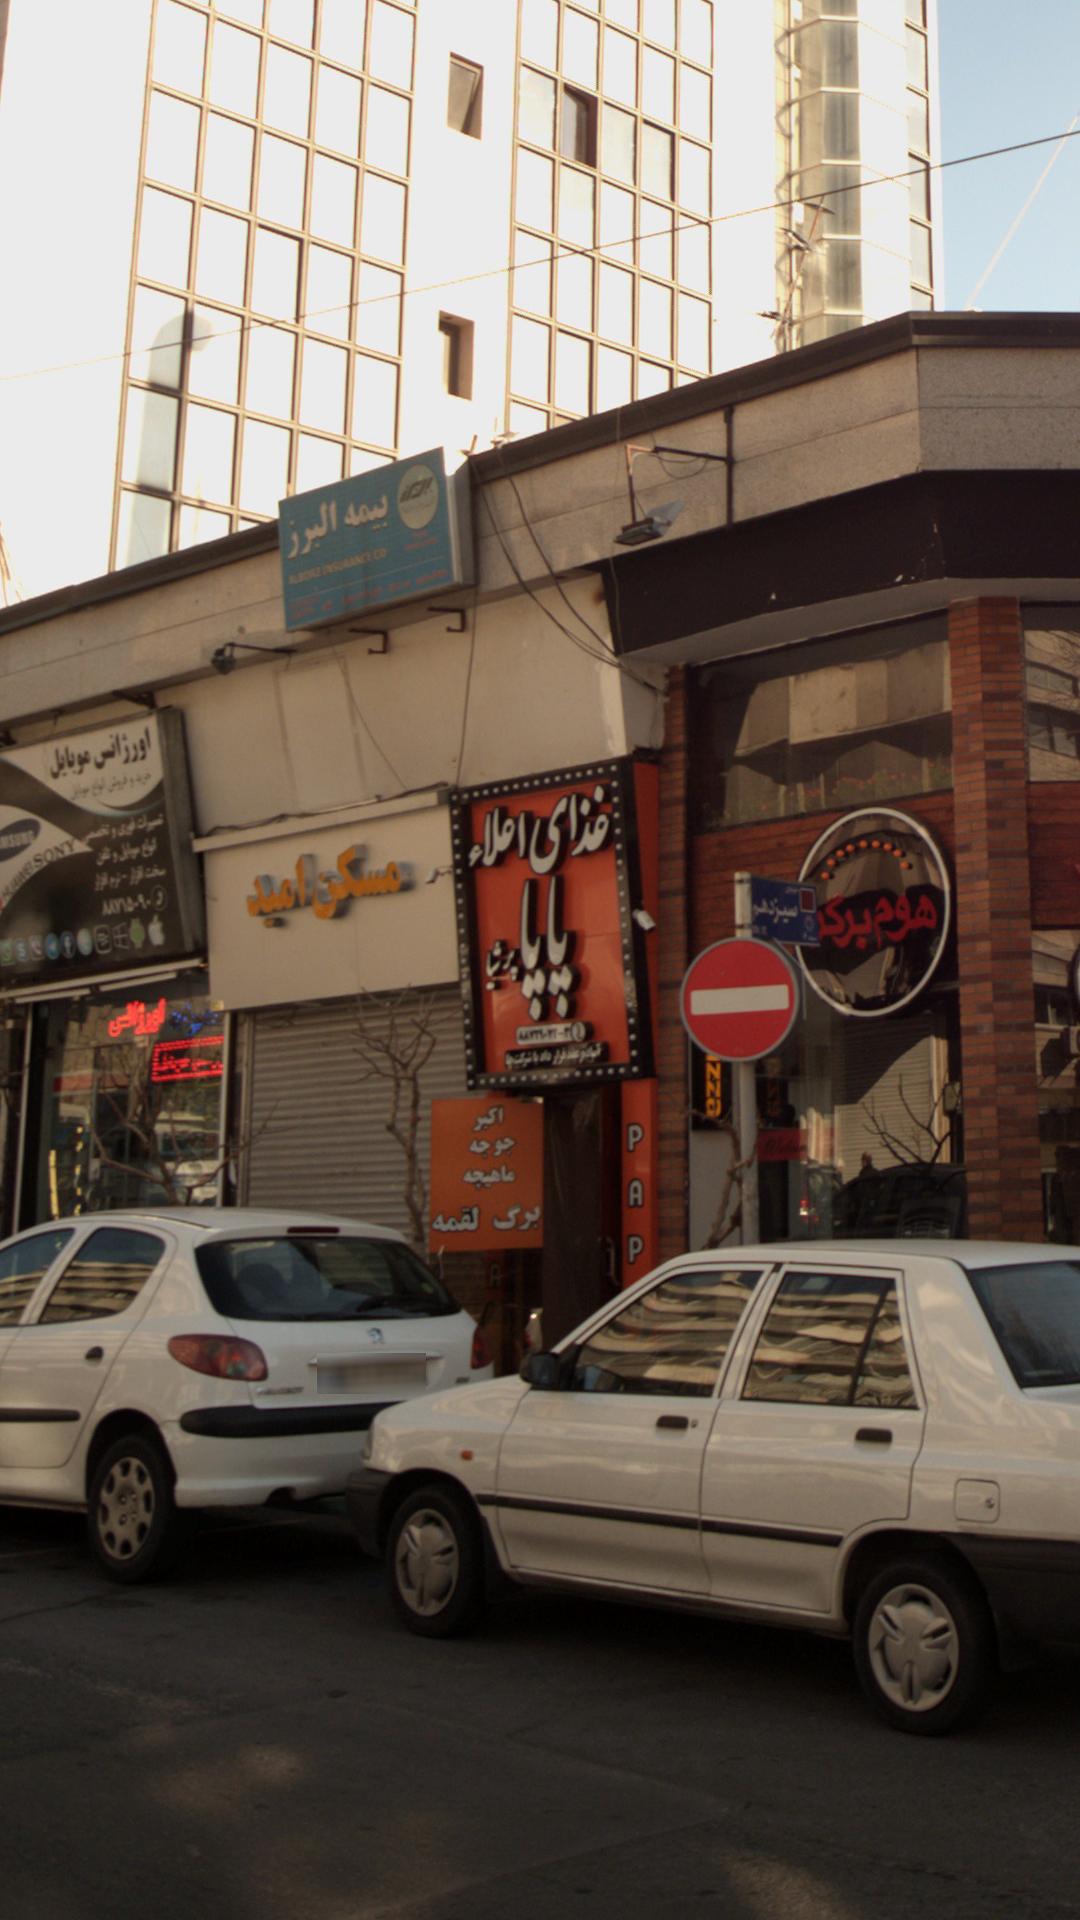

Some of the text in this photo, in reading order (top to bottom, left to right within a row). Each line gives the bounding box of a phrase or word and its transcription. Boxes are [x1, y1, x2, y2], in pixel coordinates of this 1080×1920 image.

[287, 495, 389, 560] بیمه البرز
[50, 727, 151, 779] اورژانس موبایل
[530, 785, 610, 874] غذای
[32, 837, 76, 868] SONY
[247, 845, 408, 928] مسکن امید
[752, 898, 799, 924] سیزدهم
[874, 895, 938, 950] هوم
[473, 1107, 504, 1131] اکبر
[469, 1135, 515, 1157] جوجه
[463, 1164, 516, 1189] ماهیچه
[432, 1203, 541, 1232] برگ لقمه
